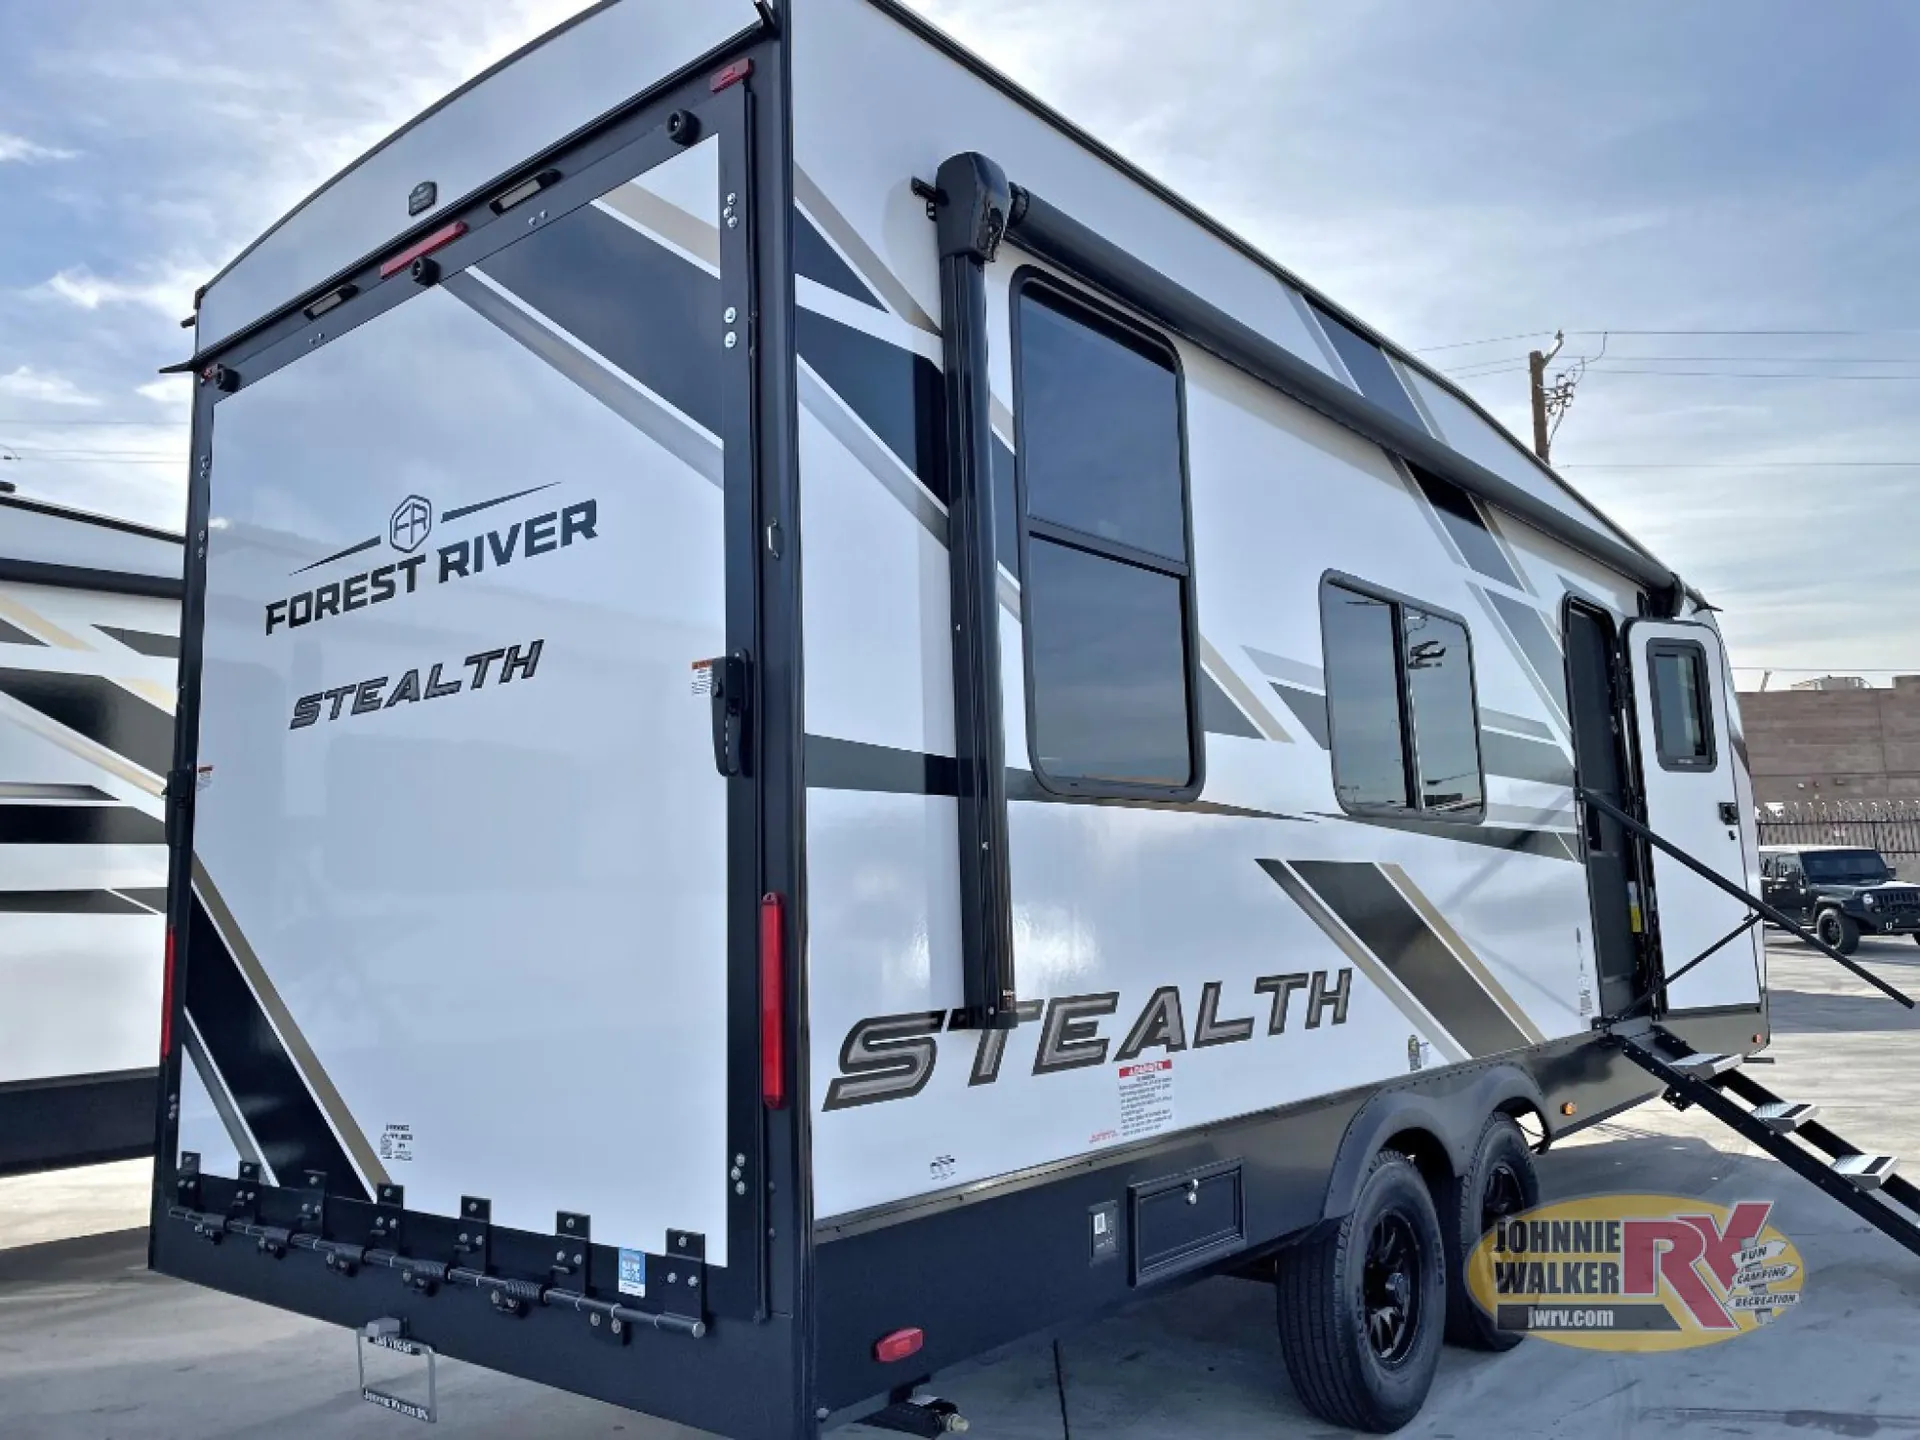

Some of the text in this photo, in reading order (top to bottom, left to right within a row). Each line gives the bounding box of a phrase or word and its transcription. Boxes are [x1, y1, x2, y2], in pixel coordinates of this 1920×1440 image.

[265, 499, 598, 636] FOREST RIVER
[289, 639, 545, 730] STEALTH
